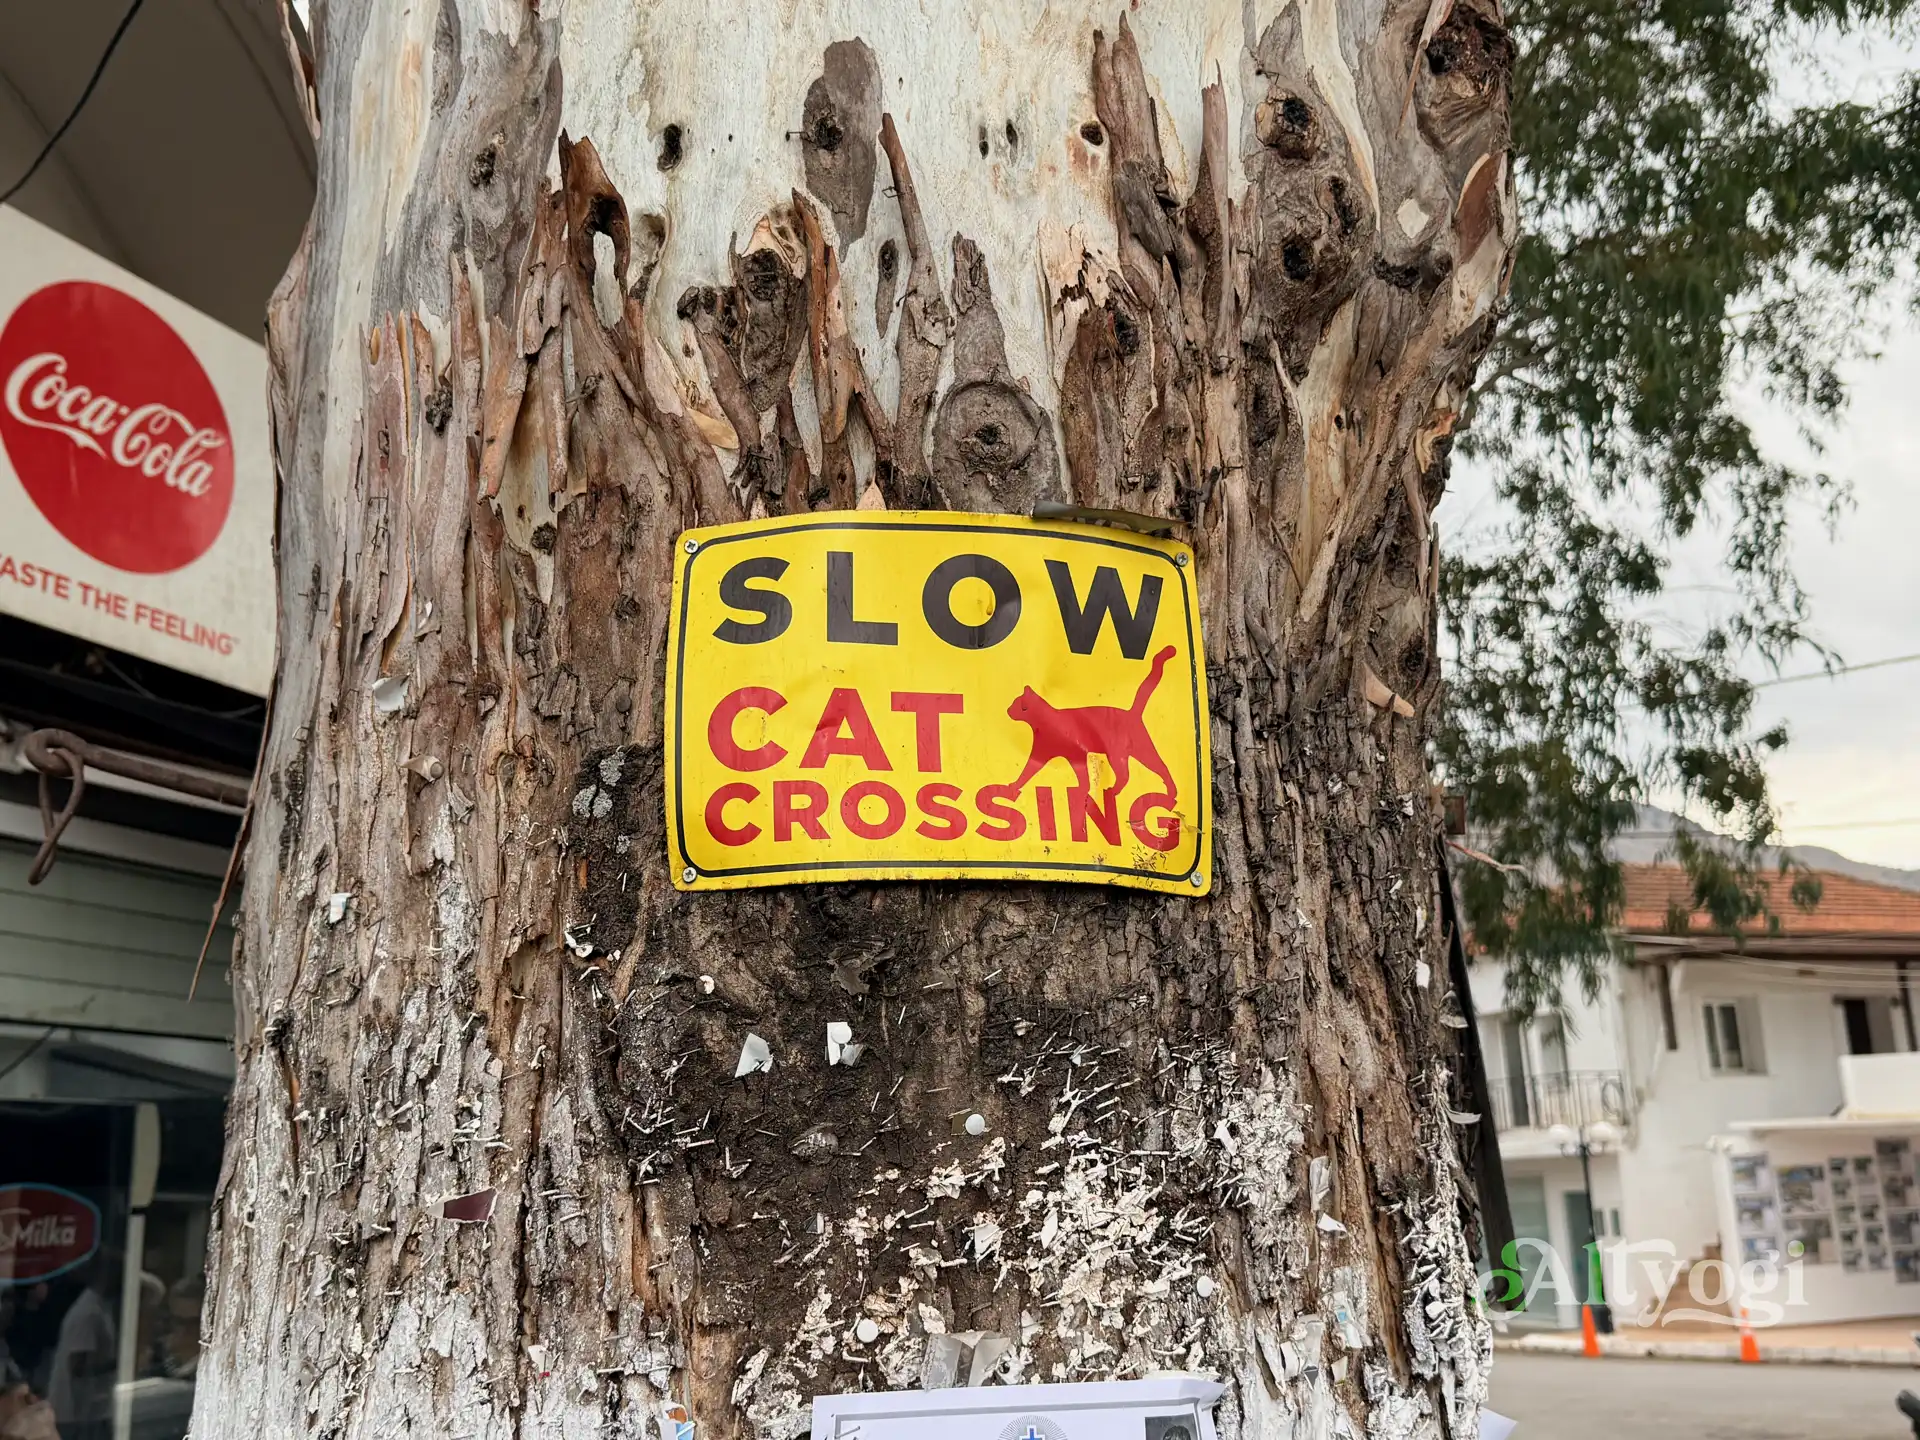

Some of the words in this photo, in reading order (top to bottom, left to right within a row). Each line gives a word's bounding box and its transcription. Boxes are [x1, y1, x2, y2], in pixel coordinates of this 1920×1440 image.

[6, 353, 226, 497] Coca-Cola
[0, 554, 72, 600] ASTE
[77, 579, 129, 620] THE
[712, 551, 1164, 660] SLOW
[708, 686, 964, 773] CAT
[704, 780, 1182, 851] CROSSING
